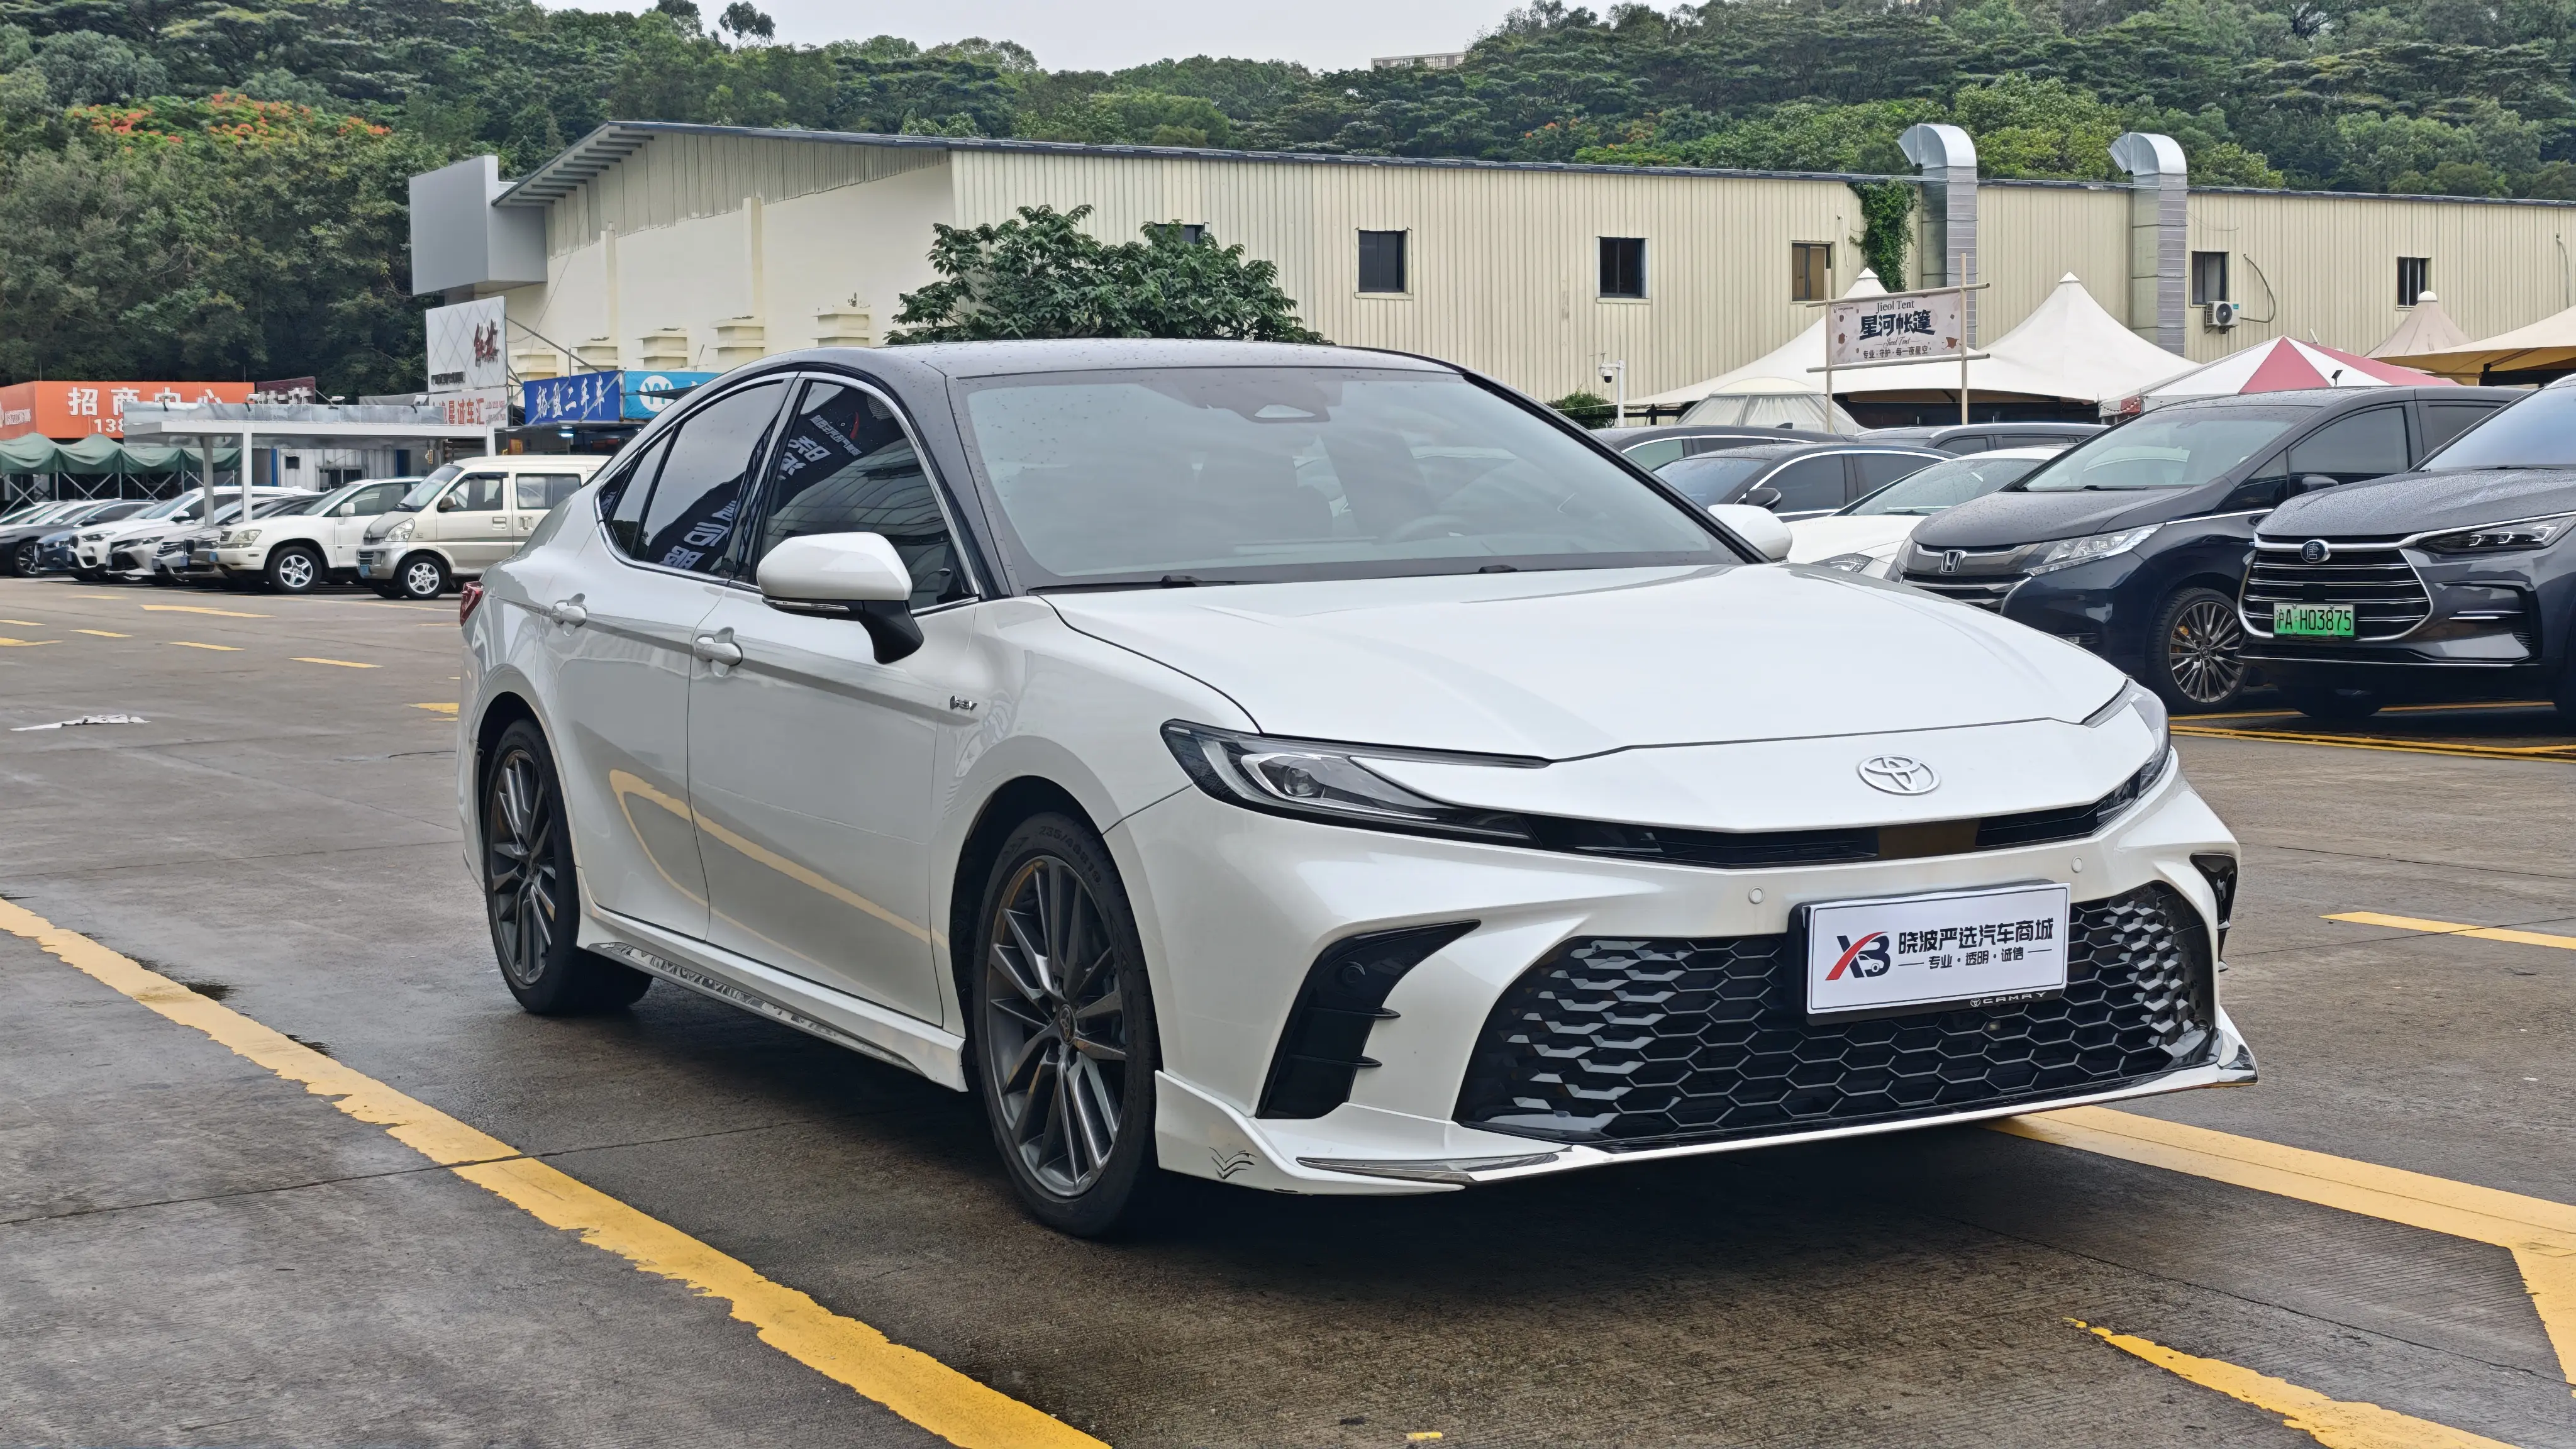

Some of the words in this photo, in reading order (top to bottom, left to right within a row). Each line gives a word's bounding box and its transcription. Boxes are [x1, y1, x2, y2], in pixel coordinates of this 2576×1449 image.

[1896, 300, 1915, 309] Tent
[1859, 309, 1936, 340] 星河帐篷
[1898, 918, 2054, 955] 晓波严选汽车商城
